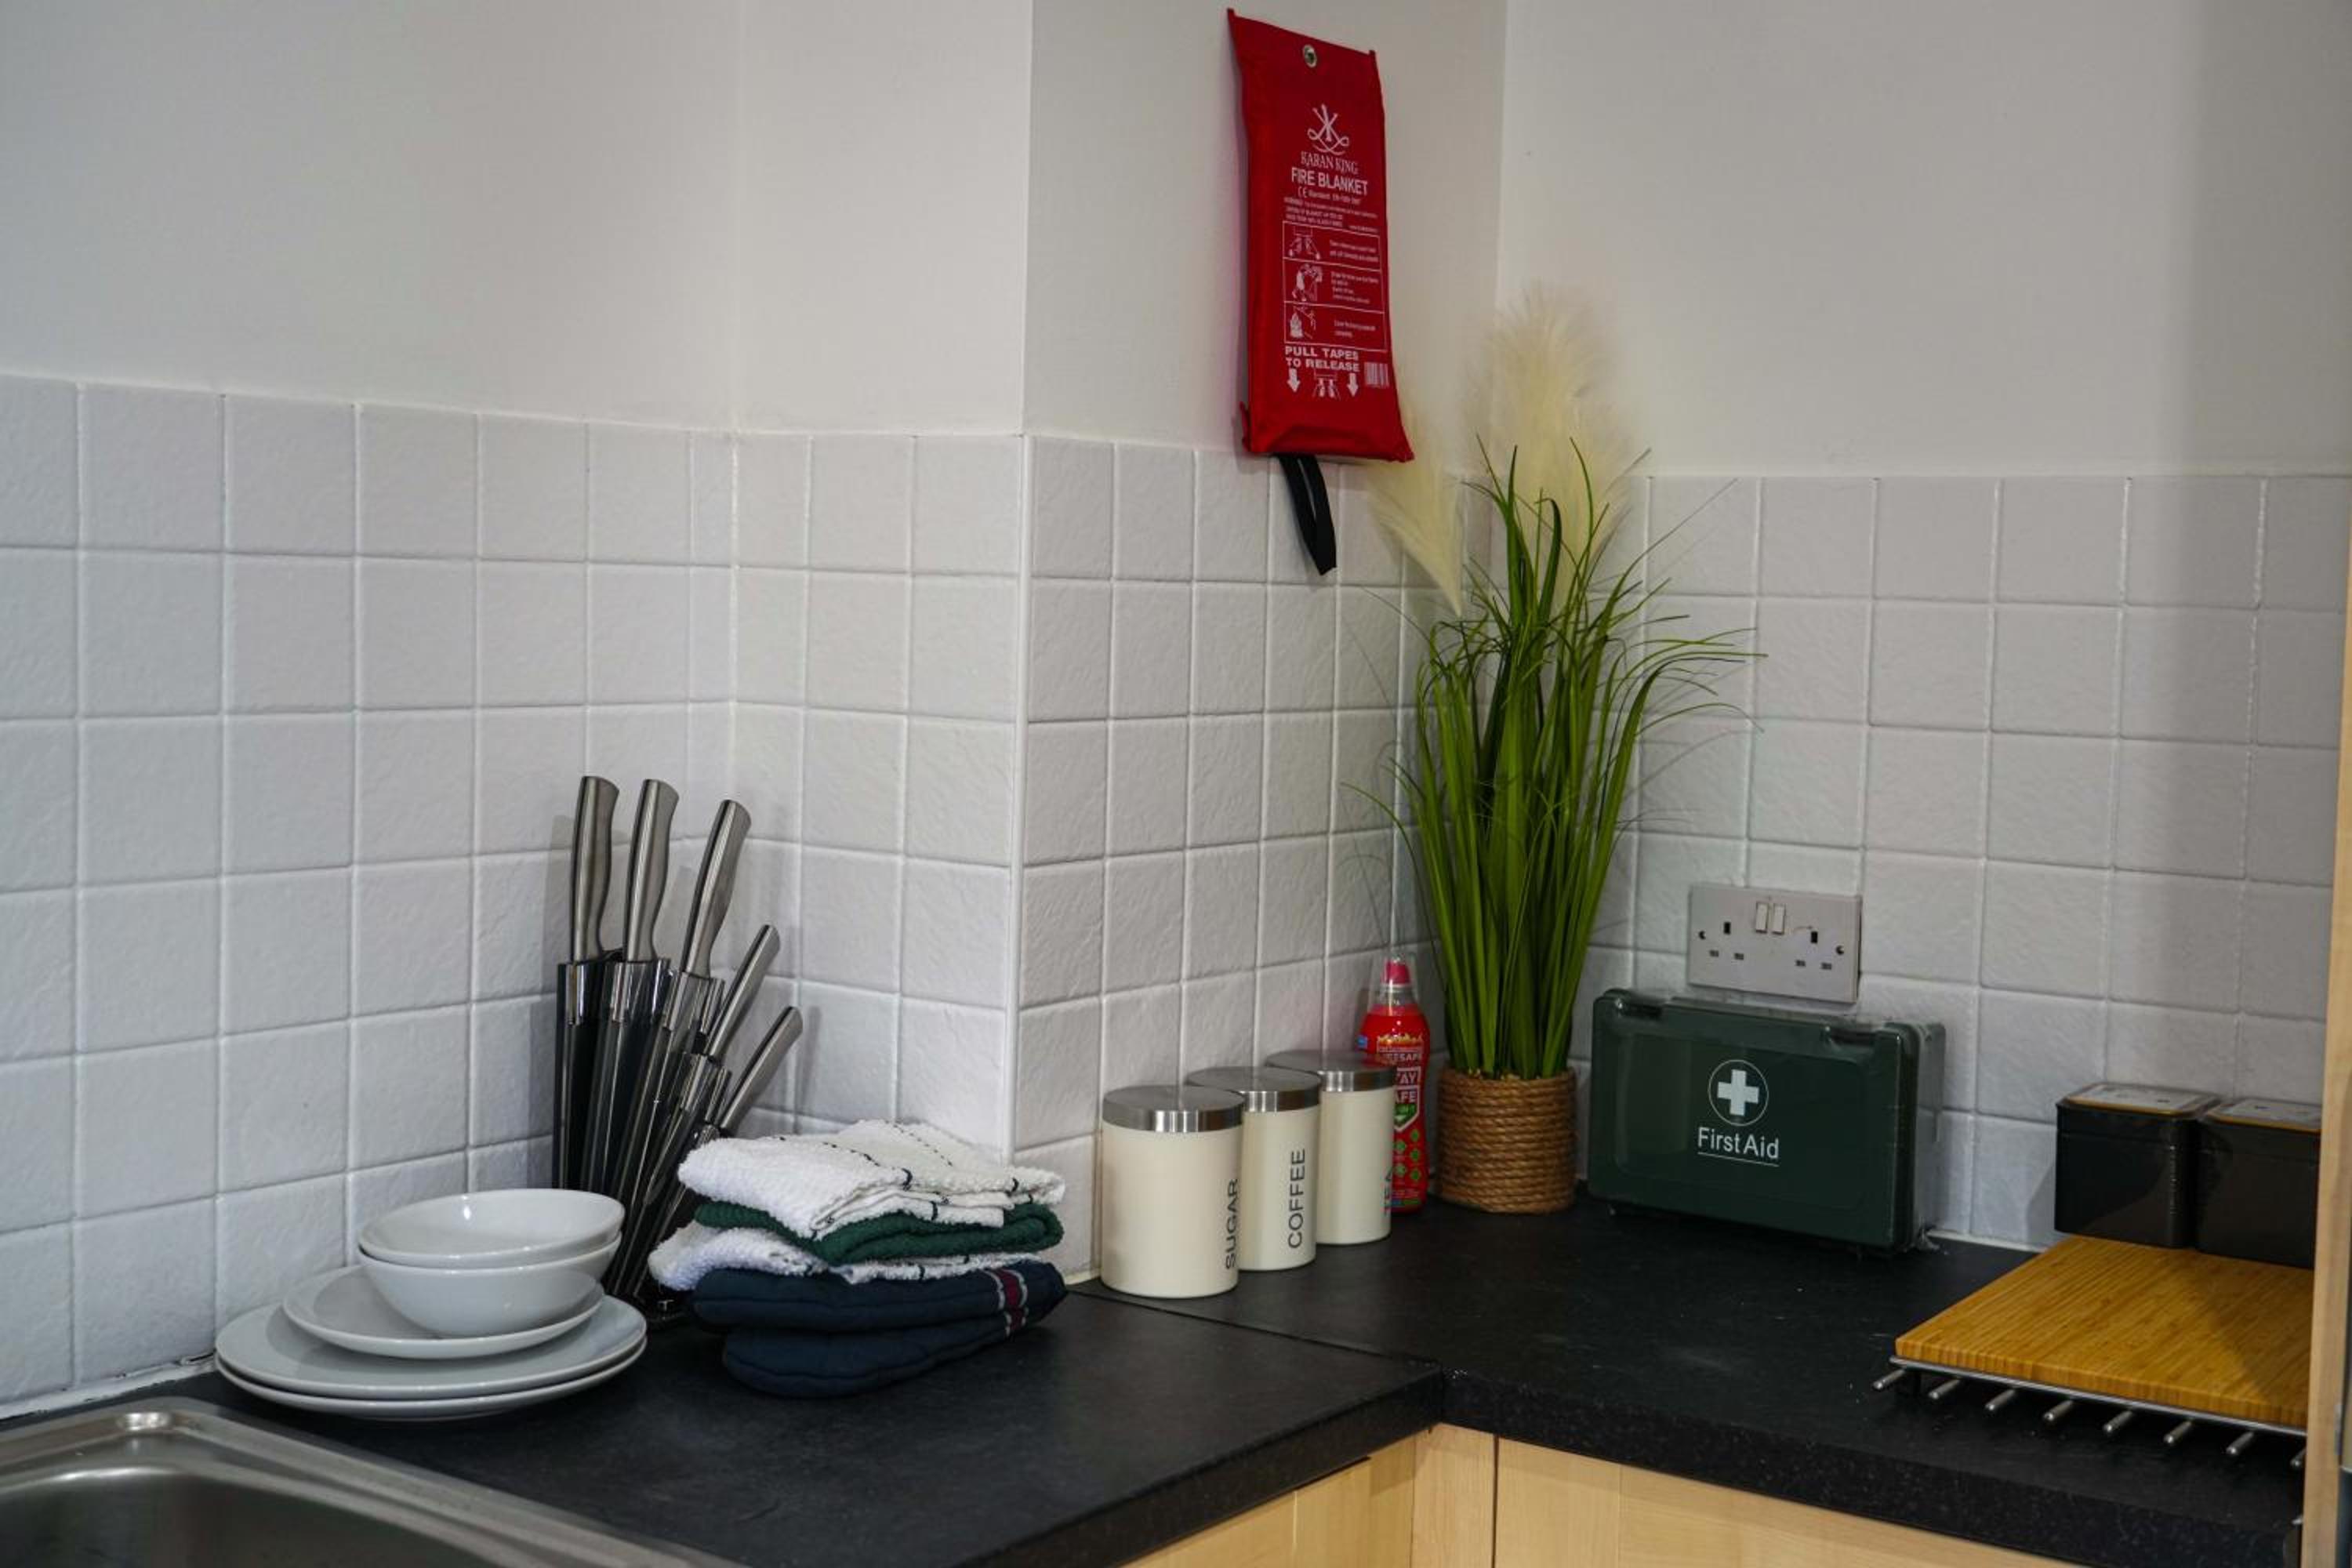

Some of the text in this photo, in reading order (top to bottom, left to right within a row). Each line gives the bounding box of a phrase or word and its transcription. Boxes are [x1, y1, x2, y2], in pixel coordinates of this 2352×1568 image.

[1291, 167, 1368, 196] FIRE BLANKET
[1285, 346, 1359, 361] PULL TAPES
[1286, 358, 1360, 372] TO RELEASE
[1697, 1127, 1780, 1160] First Aid
[1288, 1149, 1306, 1249] COFFEE
[1225, 1178, 1239, 1270] SUGAR
